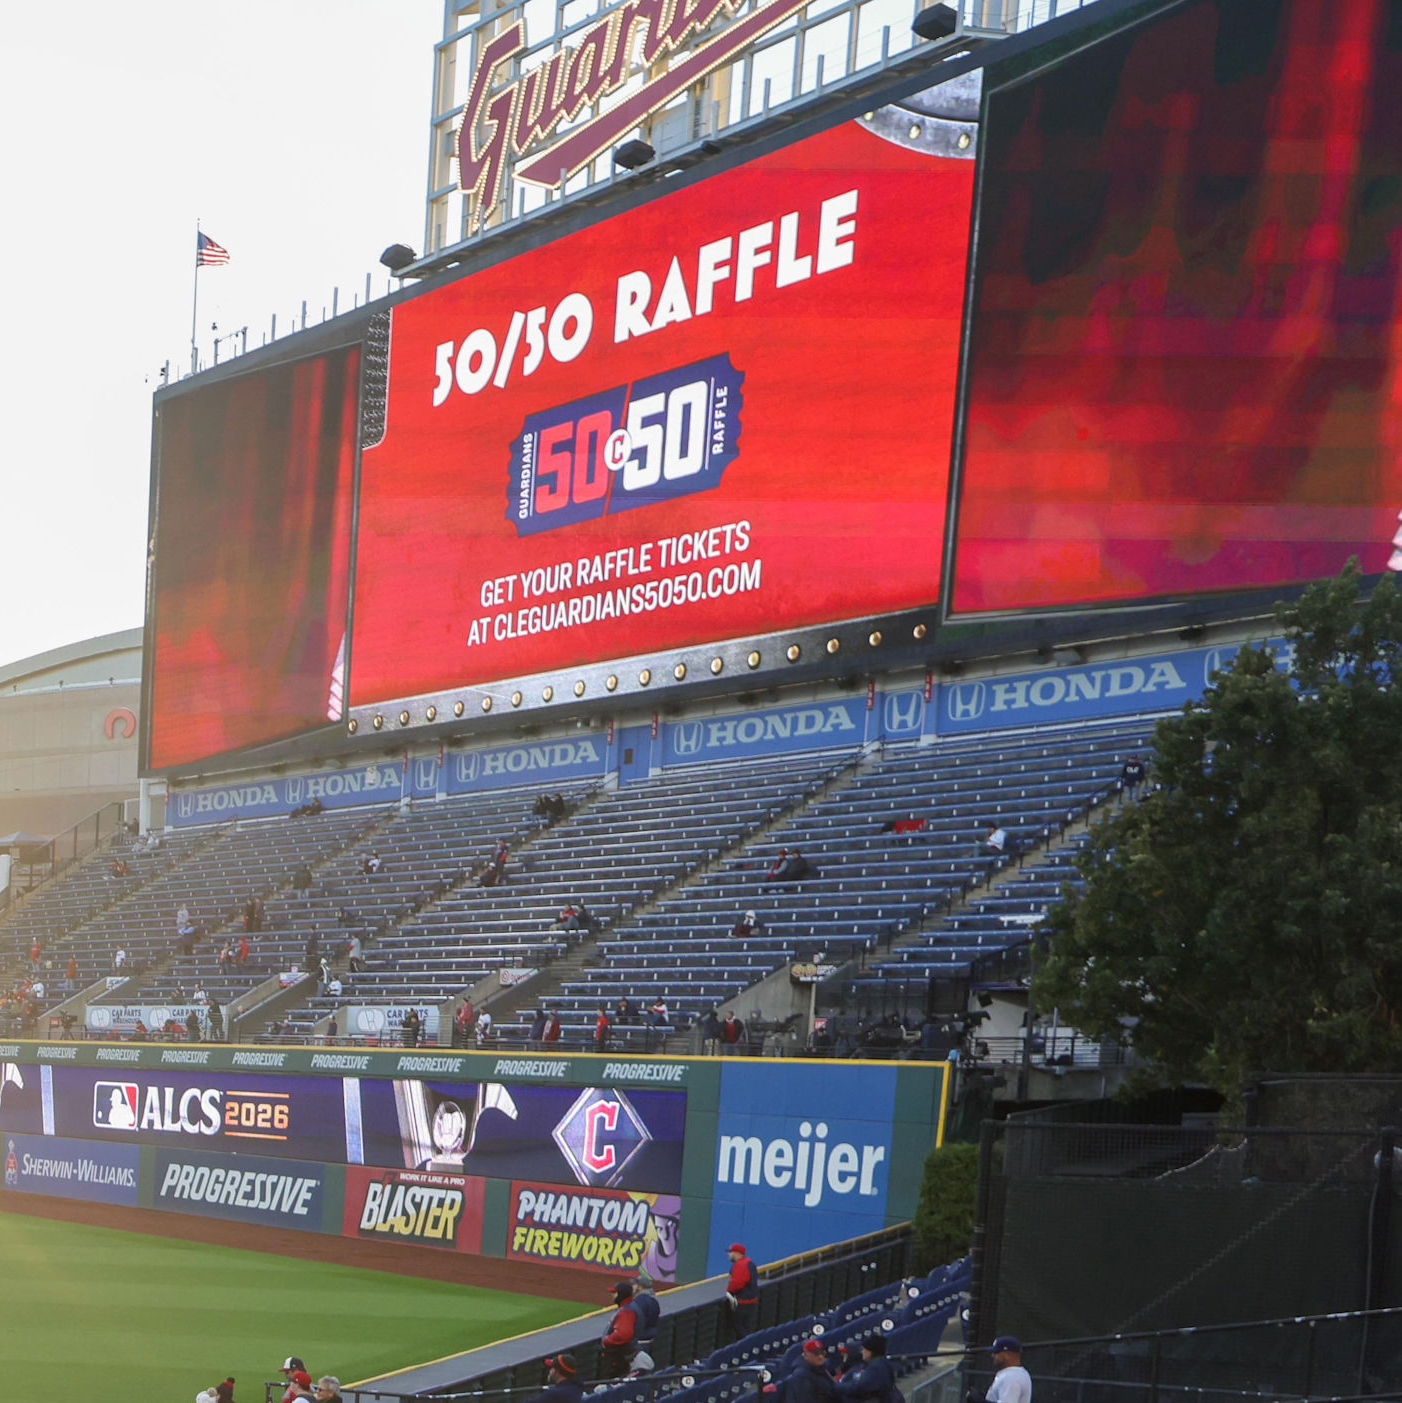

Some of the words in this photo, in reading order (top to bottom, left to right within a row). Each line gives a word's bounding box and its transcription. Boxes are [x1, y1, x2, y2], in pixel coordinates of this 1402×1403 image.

[432, 293, 593, 408] 50/50
[614, 189, 859, 343] RAFFLE
[712, 385, 727, 454] RAFFLE
[535, 410, 612, 514] 50
[623, 380, 708, 491] 50
[518, 432, 533, 519] GUARDIANS
[480, 575, 517, 607] GET
[521, 562, 572, 598] YOUR
[576, 543, 654, 586] RAFFLE
[657, 520, 751, 568] TICKETS
[467, 617, 491, 646] AT
[494, 559, 762, 641] CLEGUARDIANS5050.COM
[990, 661, 1186, 712] HONDA
[705, 704, 856, 748] HONDA
[482, 740, 599, 777] HONDA
[196, 783, 279, 811] HONDA
[307, 765, 401, 798] HONDA
[112, 1009, 125, 1018] CAR
[386, 1008, 401, 1018] CAR
[37, 1046, 78, 1059] PROGRESSIVE
[96, 1048, 141, 1062] PROGRESSIVE
[161, 1050, 211, 1064] PROGRESSIVE
[232, 1052, 287, 1067] PROGRESSIVE
[310, 1054, 370, 1070] PROGRESSIVE
[398, 1056, 463, 1073] PROGRESSIVE
[494, 1059, 567, 1077] PROGRESSIVE
[603, 1062, 686, 1082] PROGRESSIVE
[141, 1086, 221, 1136] ALCS
[225, 1101, 289, 1130] 2026
[21, 1153, 135, 1188] SHERWIN-WILLIAMS
[400, 1172, 420, 1182] WORK
[428, 1175, 443, 1183] LIKE
[450, 1177, 465, 1185] PRO
[717, 1121, 885, 1207] meijer
[161, 1164, 319, 1216] PROGRESSIVE
[360, 1182, 463, 1240] BLASTER
[516, 1190, 648, 1235] PHANTOM
[512, 1226, 644, 1268] FIREWORKS
